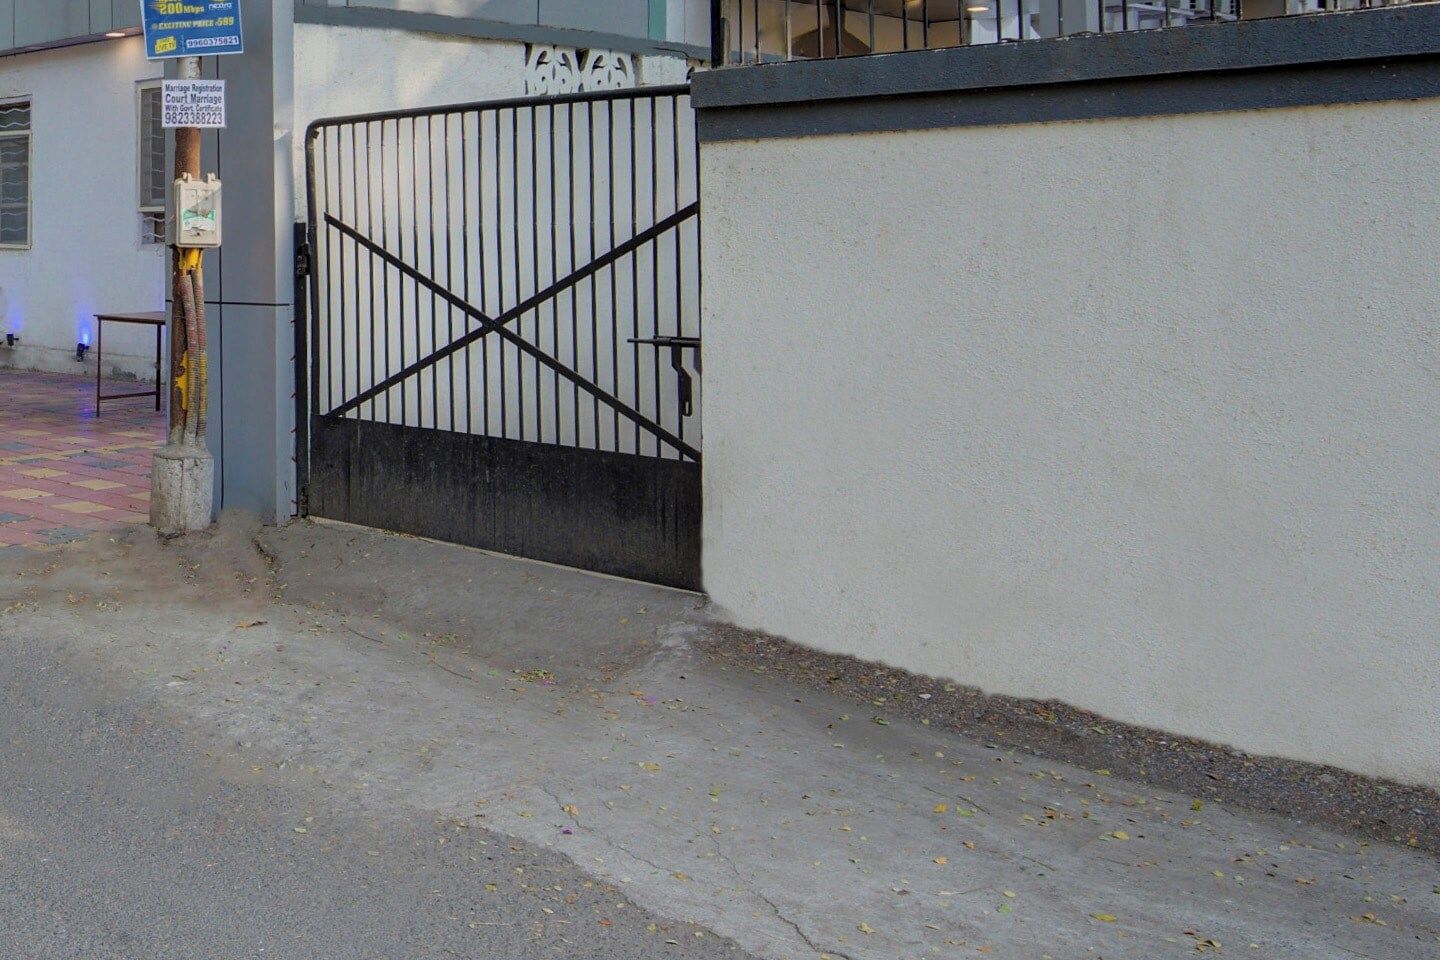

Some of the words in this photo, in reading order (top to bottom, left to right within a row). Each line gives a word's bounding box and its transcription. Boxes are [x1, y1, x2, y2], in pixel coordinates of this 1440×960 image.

[159, 2, 183, 15] 200
[183, 5, 205, 14] Mbps
[192, 20, 214, 28] PRICE
[165, 84, 190, 94] Marriage
[191, 84, 222, 94] Registration
[165, 93, 188, 103] Court
[190, 93, 222, 104] Marriage
[165, 112, 222, 125] 9823388223
